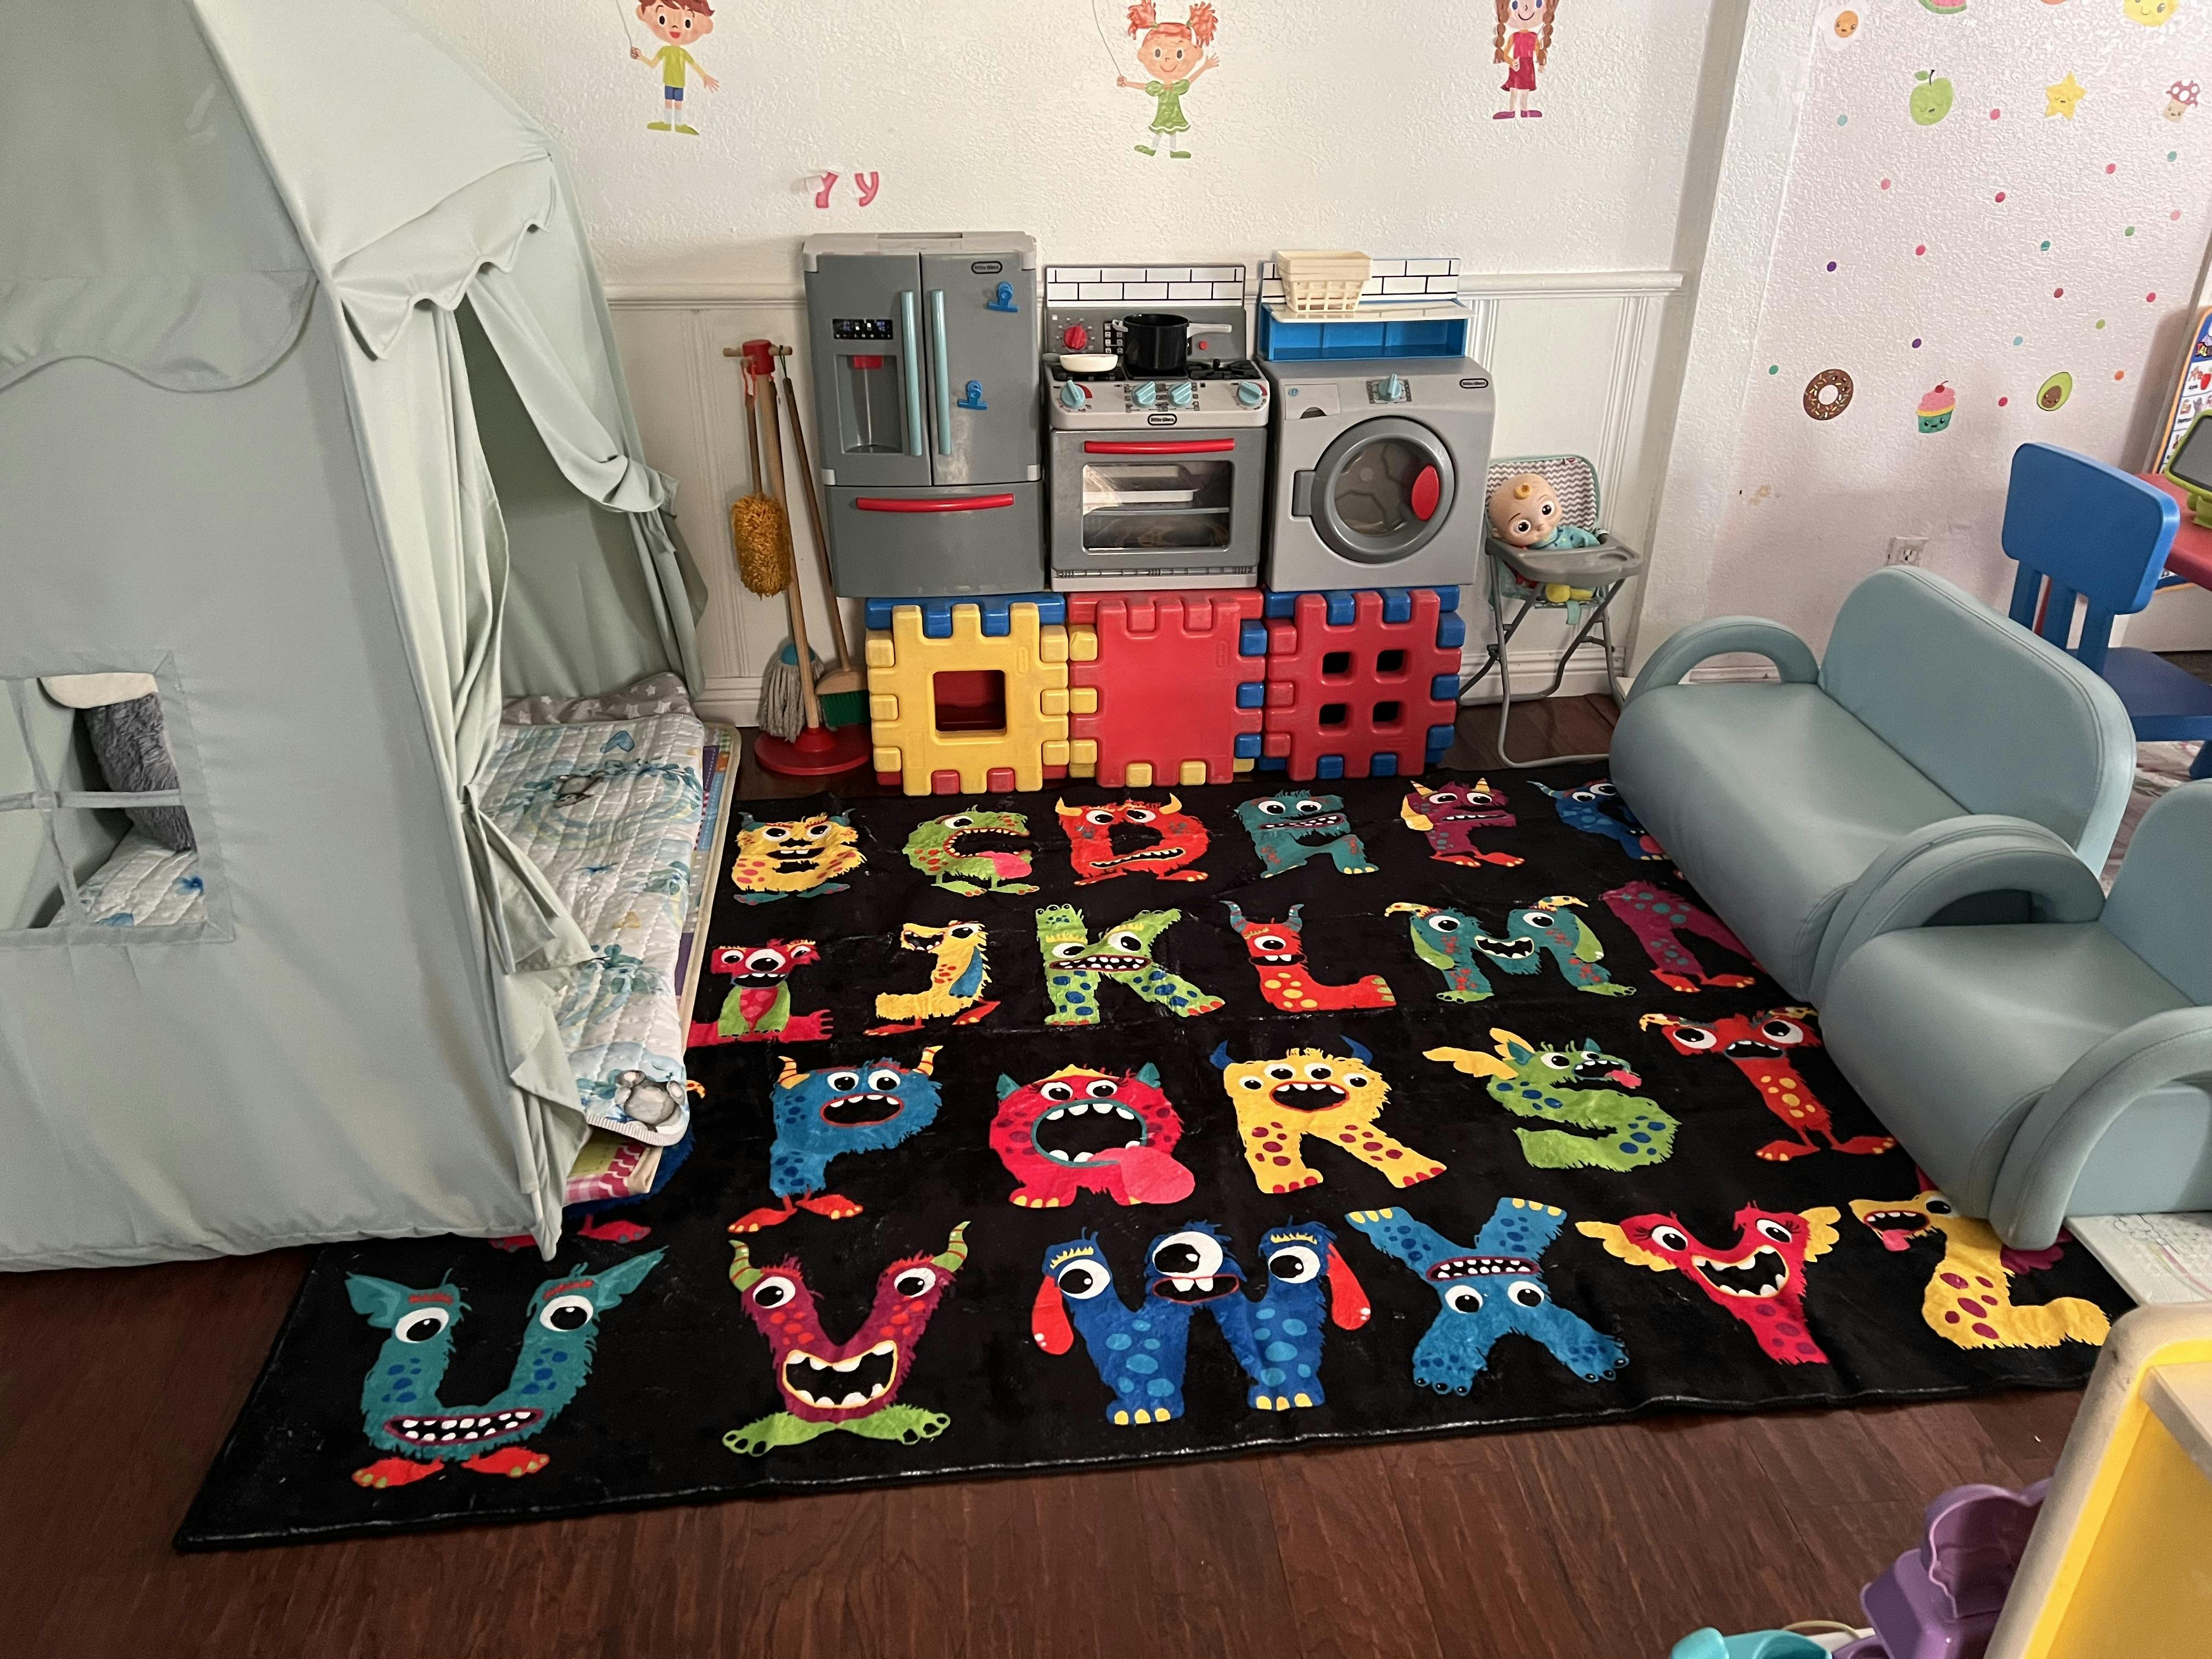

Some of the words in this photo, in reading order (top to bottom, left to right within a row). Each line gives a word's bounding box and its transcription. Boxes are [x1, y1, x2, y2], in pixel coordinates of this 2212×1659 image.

[731, 808, 866, 905] B
[1056, 793, 1211, 884] D
[864, 921, 1001, 1036] J
[1035, 904, 1225, 1025] K
[1218, 900, 1397, 1012] L
[1384, 895, 1637, 1004] M
[727, 1045, 944, 1233] P
[989, 1061, 1195, 1208] Q
[1210, 1033, 1447, 1195] R
[1423, 1028, 1681, 1172] S
[1639, 1007, 1900, 1163] T
[345, 1243, 669, 1489] U
[723, 1220, 970, 1457] V
[1031, 1215, 1370, 1426] W
[1345, 1197, 1630, 1396] X
[1575, 1199, 1840, 1364] Y
